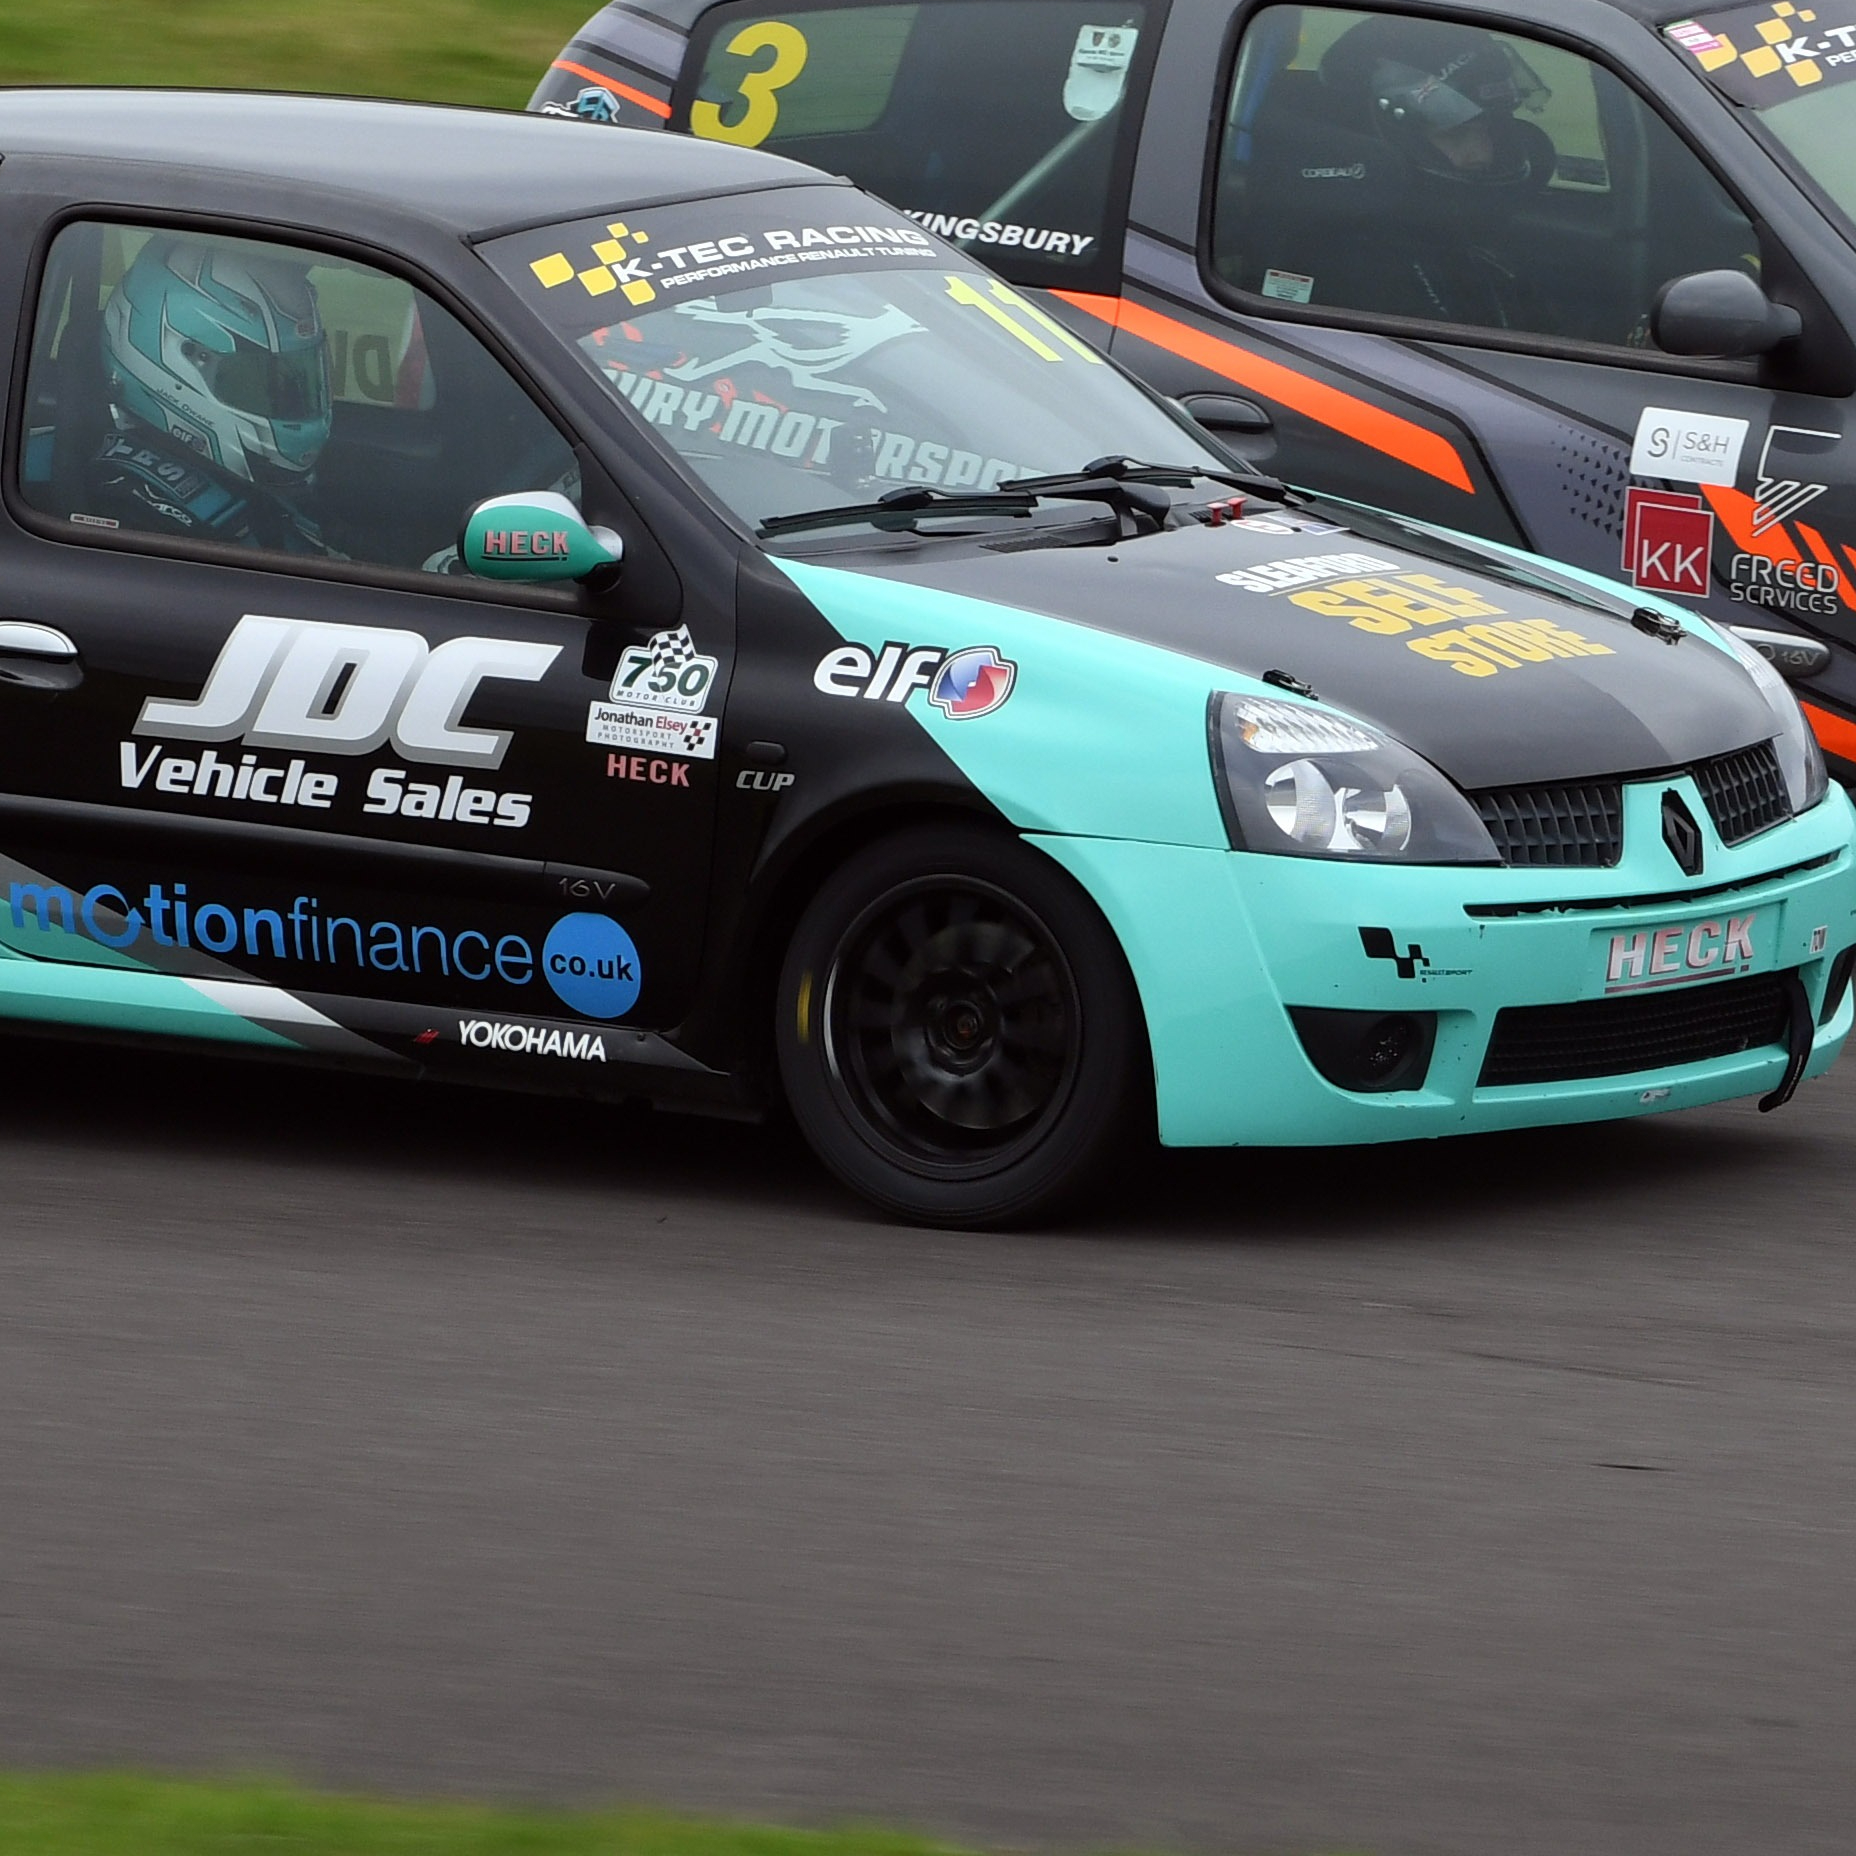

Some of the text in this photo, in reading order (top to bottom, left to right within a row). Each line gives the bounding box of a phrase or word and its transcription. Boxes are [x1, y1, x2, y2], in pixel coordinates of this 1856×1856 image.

[690, 21, 807, 148] 3
[610, 226, 929, 283] K-TEC RACING
[660, 246, 937, 289] PERFORMANCE RENAULT TUNING
[944, 275, 1103, 364] 11
[156, 388, 216, 428] JACK DWANE
[172, 427, 195, 443] elf
[718, 397, 1050, 492] MOTRSPO
[1683, 431, 1730, 455] S&H
[484, 530, 570, 555] HECK
[1641, 538, 1705, 587] KK
[1214, 552, 1402, 593] SLEAFORD
[1730, 553, 1839, 593] FREED
[1287, 573, 1509, 636] SELF
[1405, 618, 1618, 677] STORE
[132, 613, 565, 769] JDC
[621, 655, 710, 697] 750
[813, 645, 942, 704] elf
[616, 689, 696, 707] MOTOR CLUB
[594, 707, 688, 735] Jonathan Elsey
[597, 732, 674, 749] PHOTOGRAPHY
[602, 724, 672, 739] MOTORSPORT
[118, 741, 533, 829] Vehicle Sales
[607, 753, 691, 787] HECK
[735, 770, 795, 791] CUP
[559, 877, 616, 900] 16V
[549, 951, 634, 984] co.uk
[1606, 912, 1756, 982] HECK
[457, 1020, 608, 1063] YOKOHAMA
